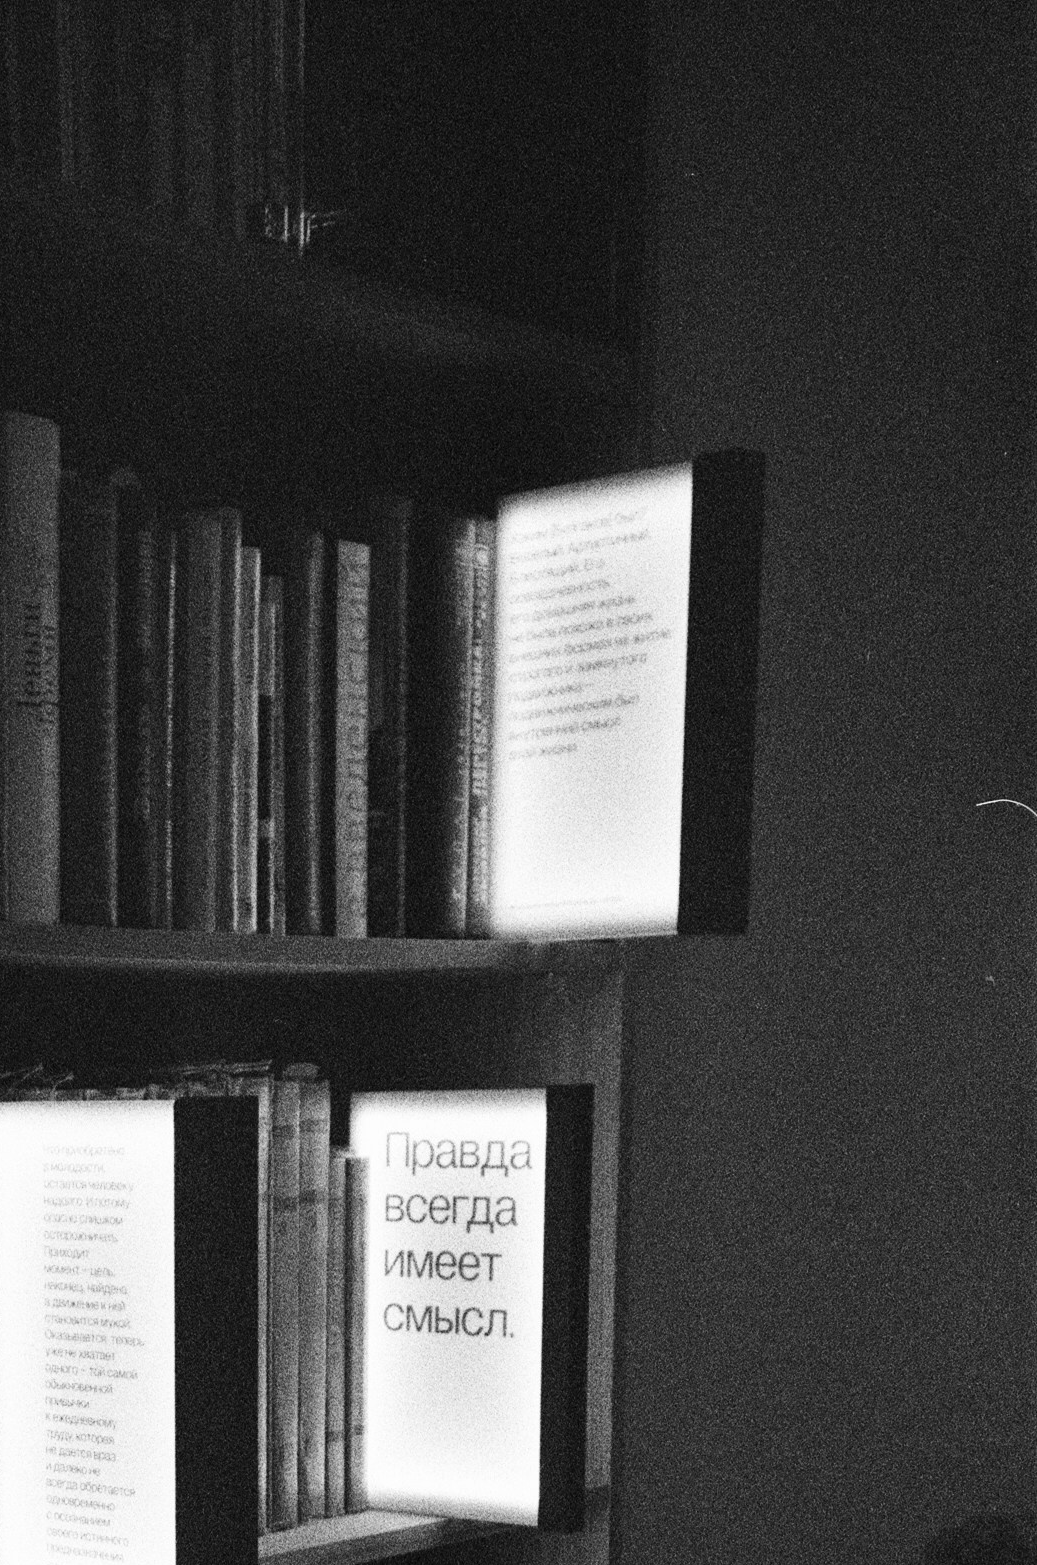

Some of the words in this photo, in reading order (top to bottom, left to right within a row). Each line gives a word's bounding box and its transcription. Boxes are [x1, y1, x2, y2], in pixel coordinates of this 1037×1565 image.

[386, 1132, 532, 1177] Правда
[384, 1194, 518, 1233] всегда
[383, 1249, 503, 1282] имеет
[382, 1302, 514, 1338] смысл.
